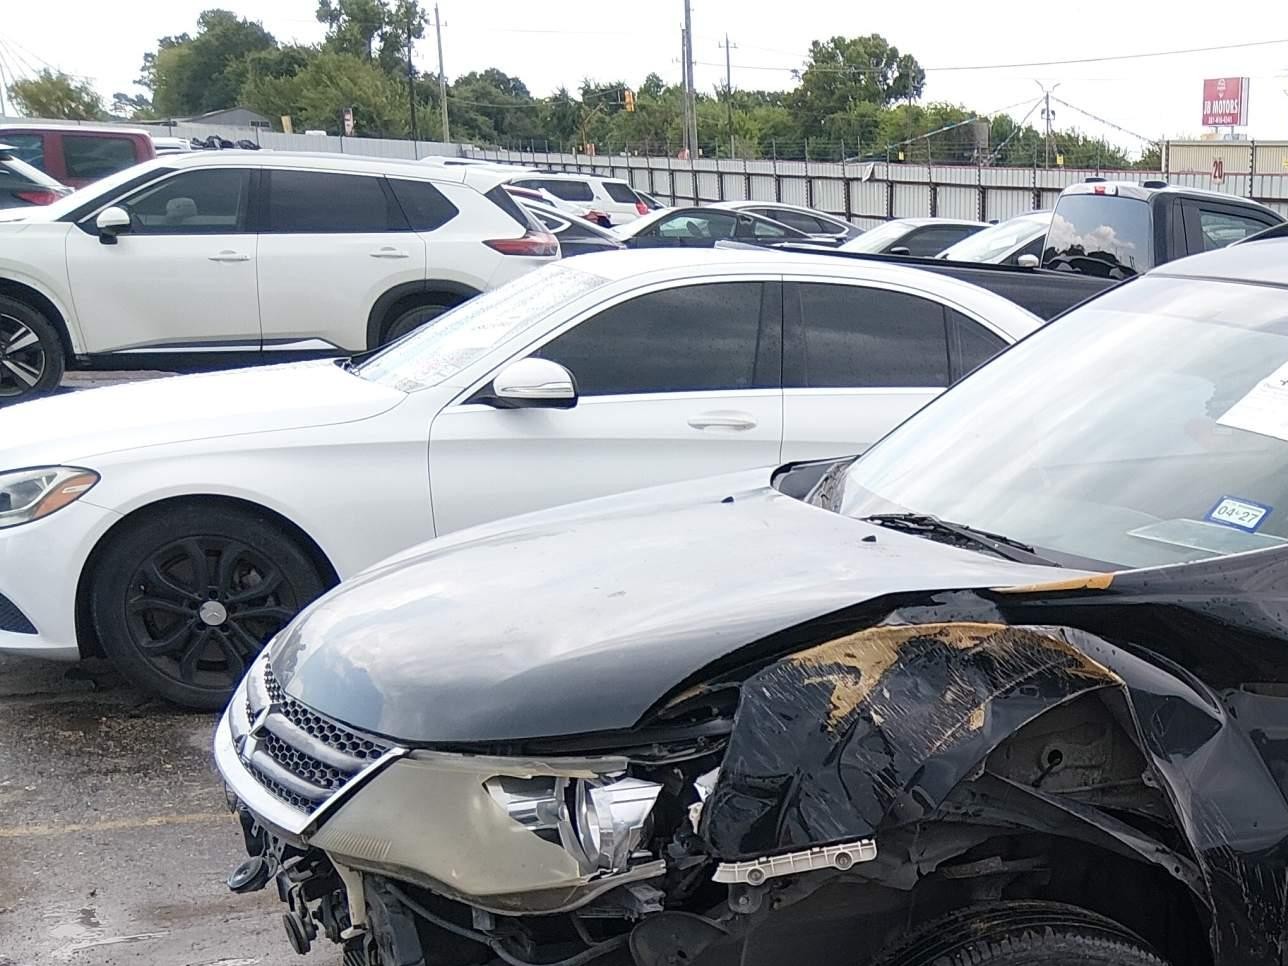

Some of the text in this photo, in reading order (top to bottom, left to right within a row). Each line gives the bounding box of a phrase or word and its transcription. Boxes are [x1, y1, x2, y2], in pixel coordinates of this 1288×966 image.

[1204, 98, 1238, 114] JB MOTORS
[1213, 160, 1223, 179] 20
[1238, 511, 1259, 523] 27
